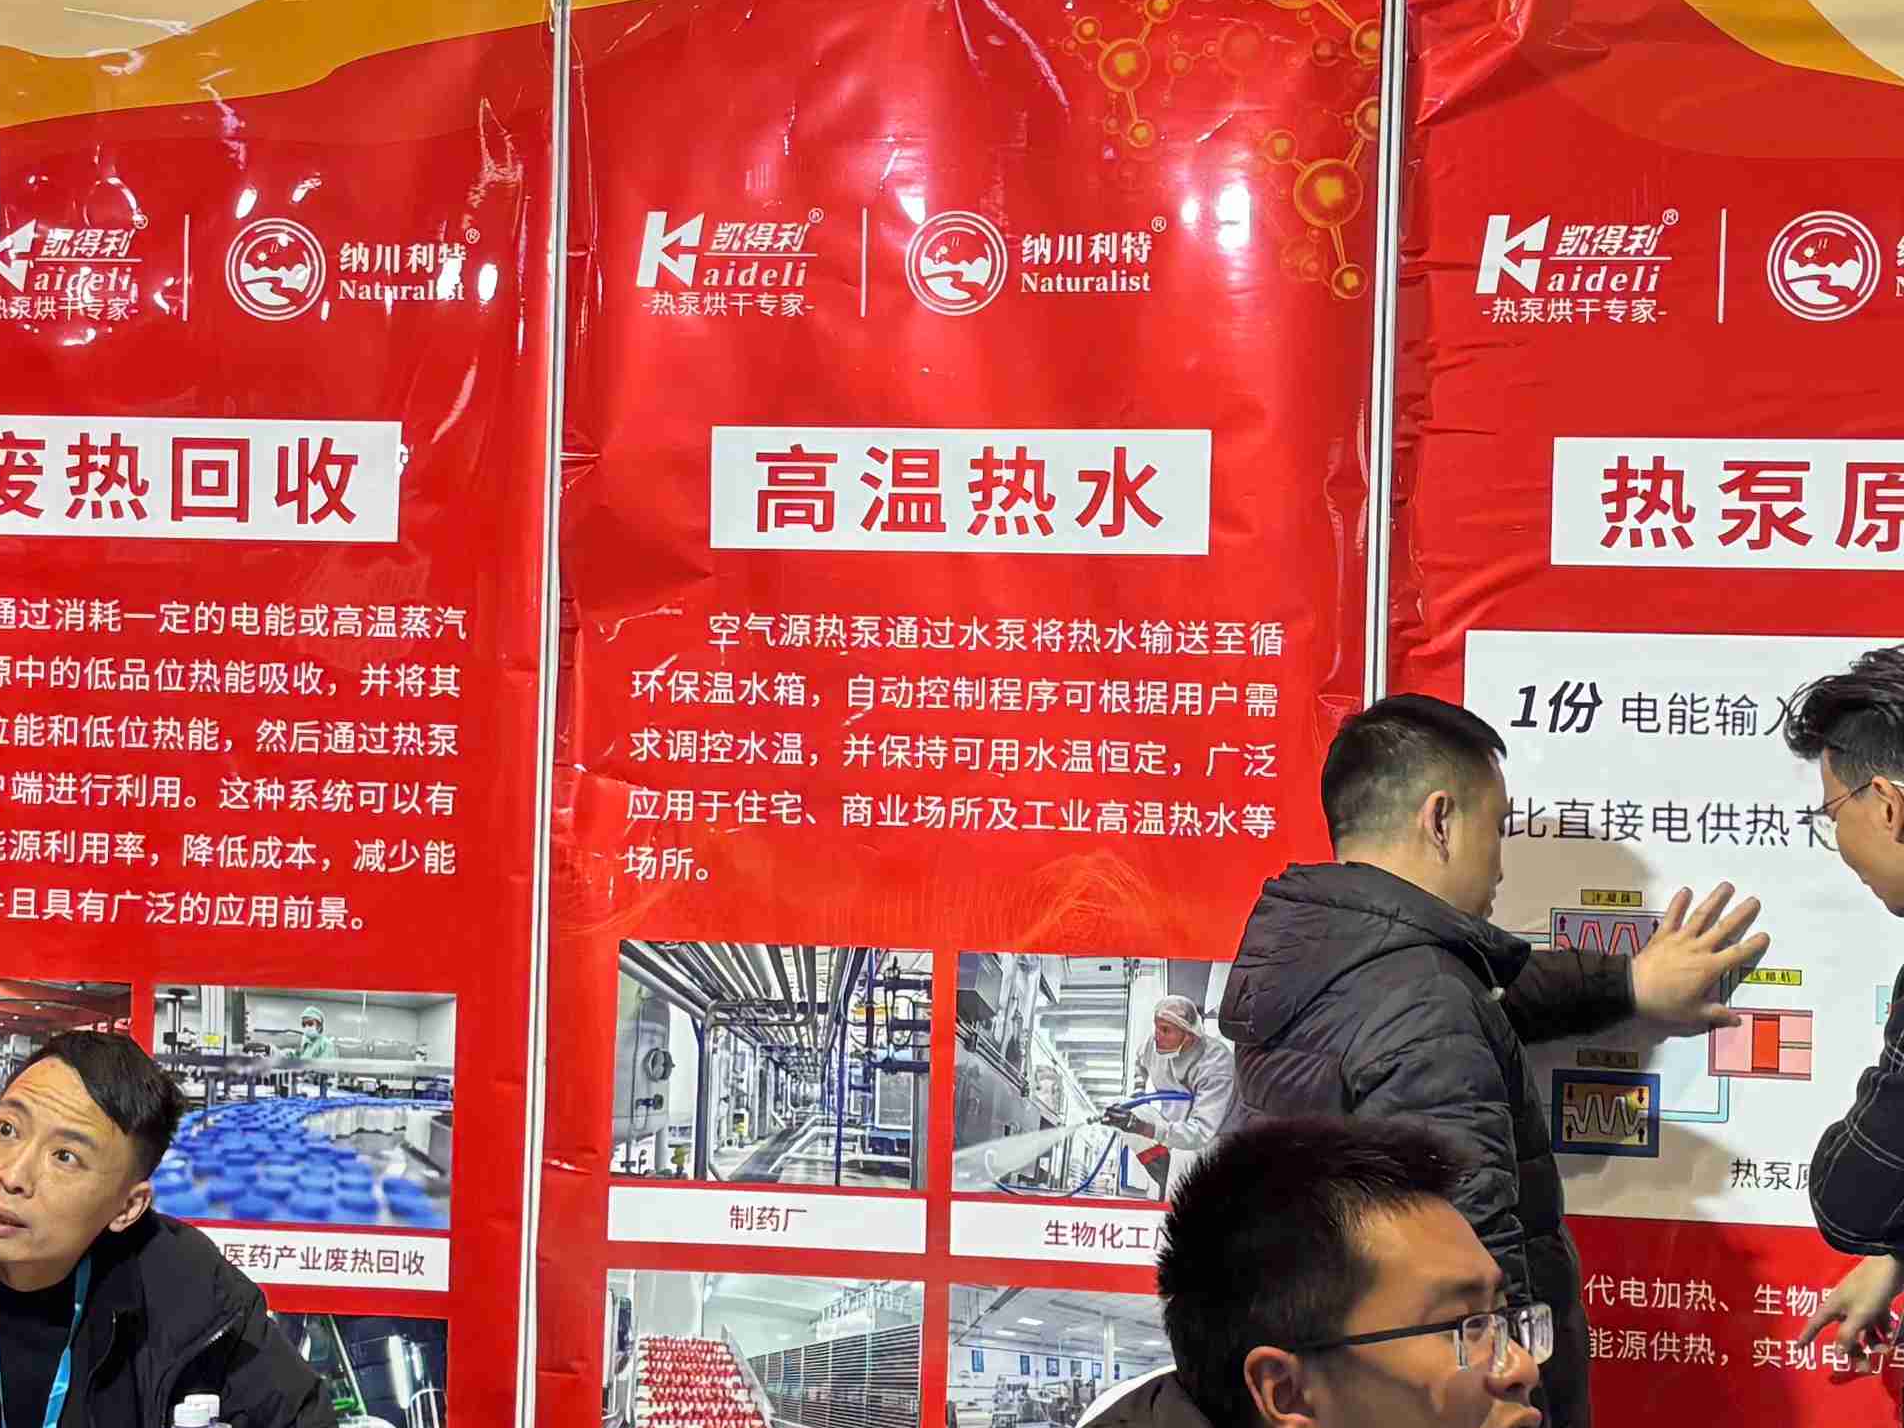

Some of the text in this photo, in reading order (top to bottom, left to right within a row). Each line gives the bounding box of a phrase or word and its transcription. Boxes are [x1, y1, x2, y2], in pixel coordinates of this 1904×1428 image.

[709, 221, 807, 252] 凯得利
[1020, 231, 1152, 265] 纳川利特
[1556, 223, 1661, 257] 凯得利
[1020, 268, 1151, 293] Naturalist
[755, 444, 1163, 537] 高温热水
[706, 611, 1284, 658] 空气源热泵通过水泵将热水输送至循
[630, 671, 1277, 718] 环保温水箱，自动控制程序可根据用户需
[1509, 679, 1602, 734] 1份
[628, 729, 1277, 779] 求调控水温，并保持可用水温恒定，广泛
[626, 788, 1276, 841] 应用于住宅、商业场所及工业高温热水等
[623, 846, 709, 882] 场所。
[729, 1204, 807, 1232] 制药厂
